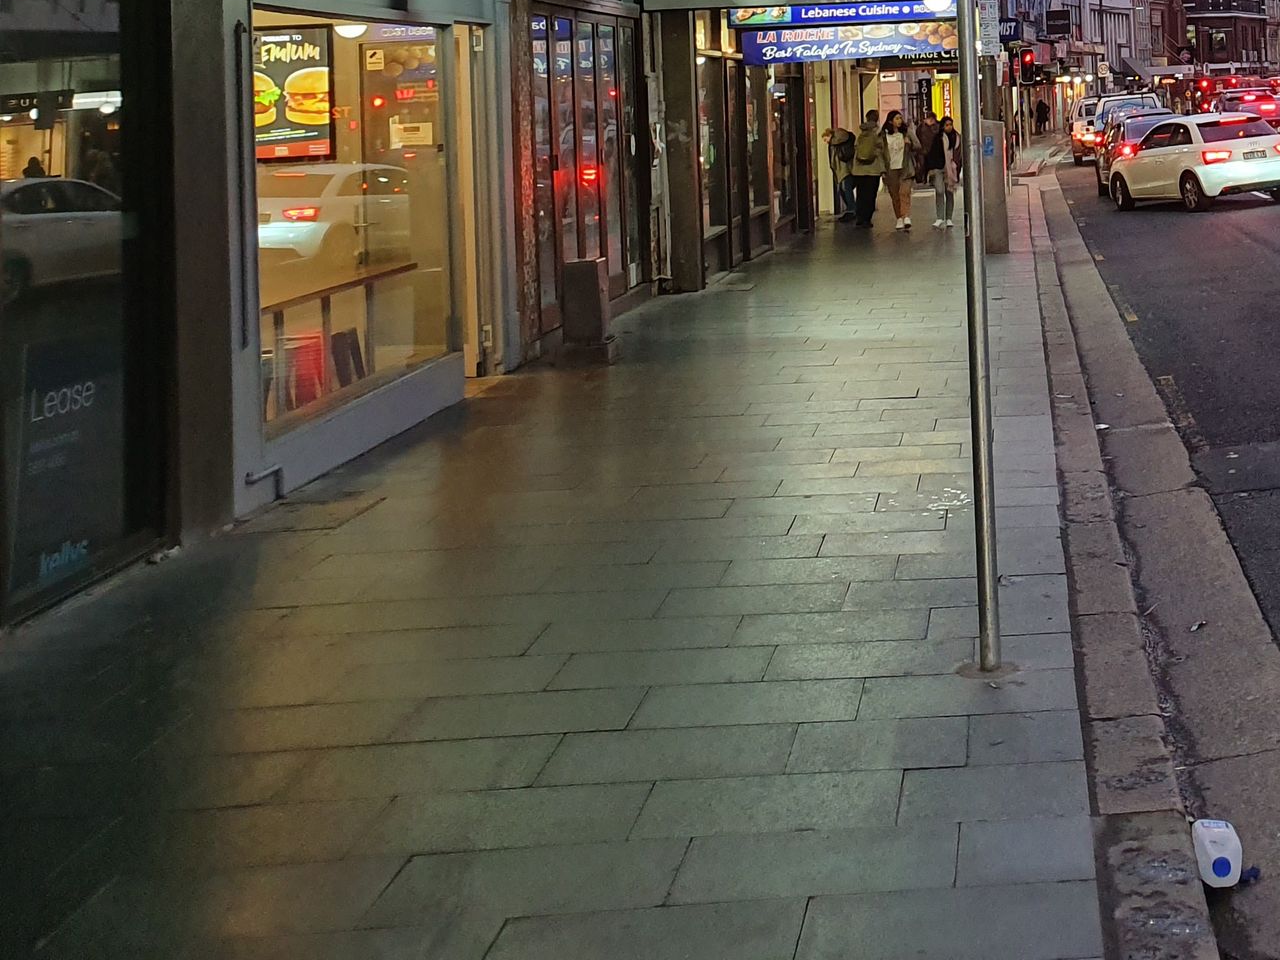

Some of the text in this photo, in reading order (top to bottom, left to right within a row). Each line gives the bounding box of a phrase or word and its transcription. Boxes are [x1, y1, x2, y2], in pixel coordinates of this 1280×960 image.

[801, 5, 899, 18] Lebanese Cuisine
[757, 31, 777, 43] LA
[762, 44, 793, 60] Best
[859, 42, 902, 56] Sydney
[898, 50, 938, 59] VINTAGE
[30, 382, 96, 423] Lease
